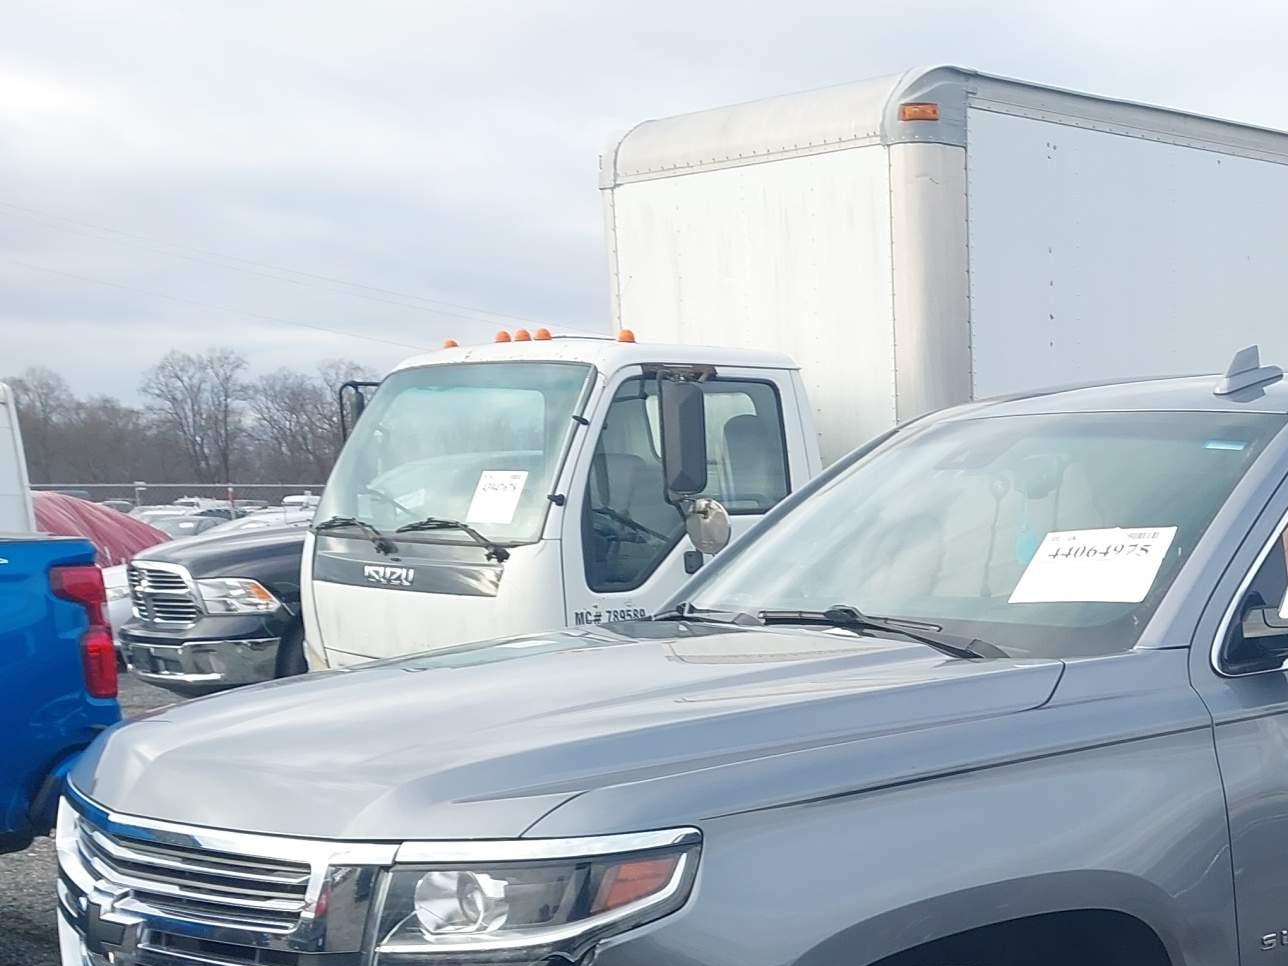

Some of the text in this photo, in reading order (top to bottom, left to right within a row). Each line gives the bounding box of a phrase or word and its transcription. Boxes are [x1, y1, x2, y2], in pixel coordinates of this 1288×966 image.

[1048, 543, 1153, 560] 44064975
[363, 565, 415, 587] ISUZU
[574, 610, 602, 626] MC#
